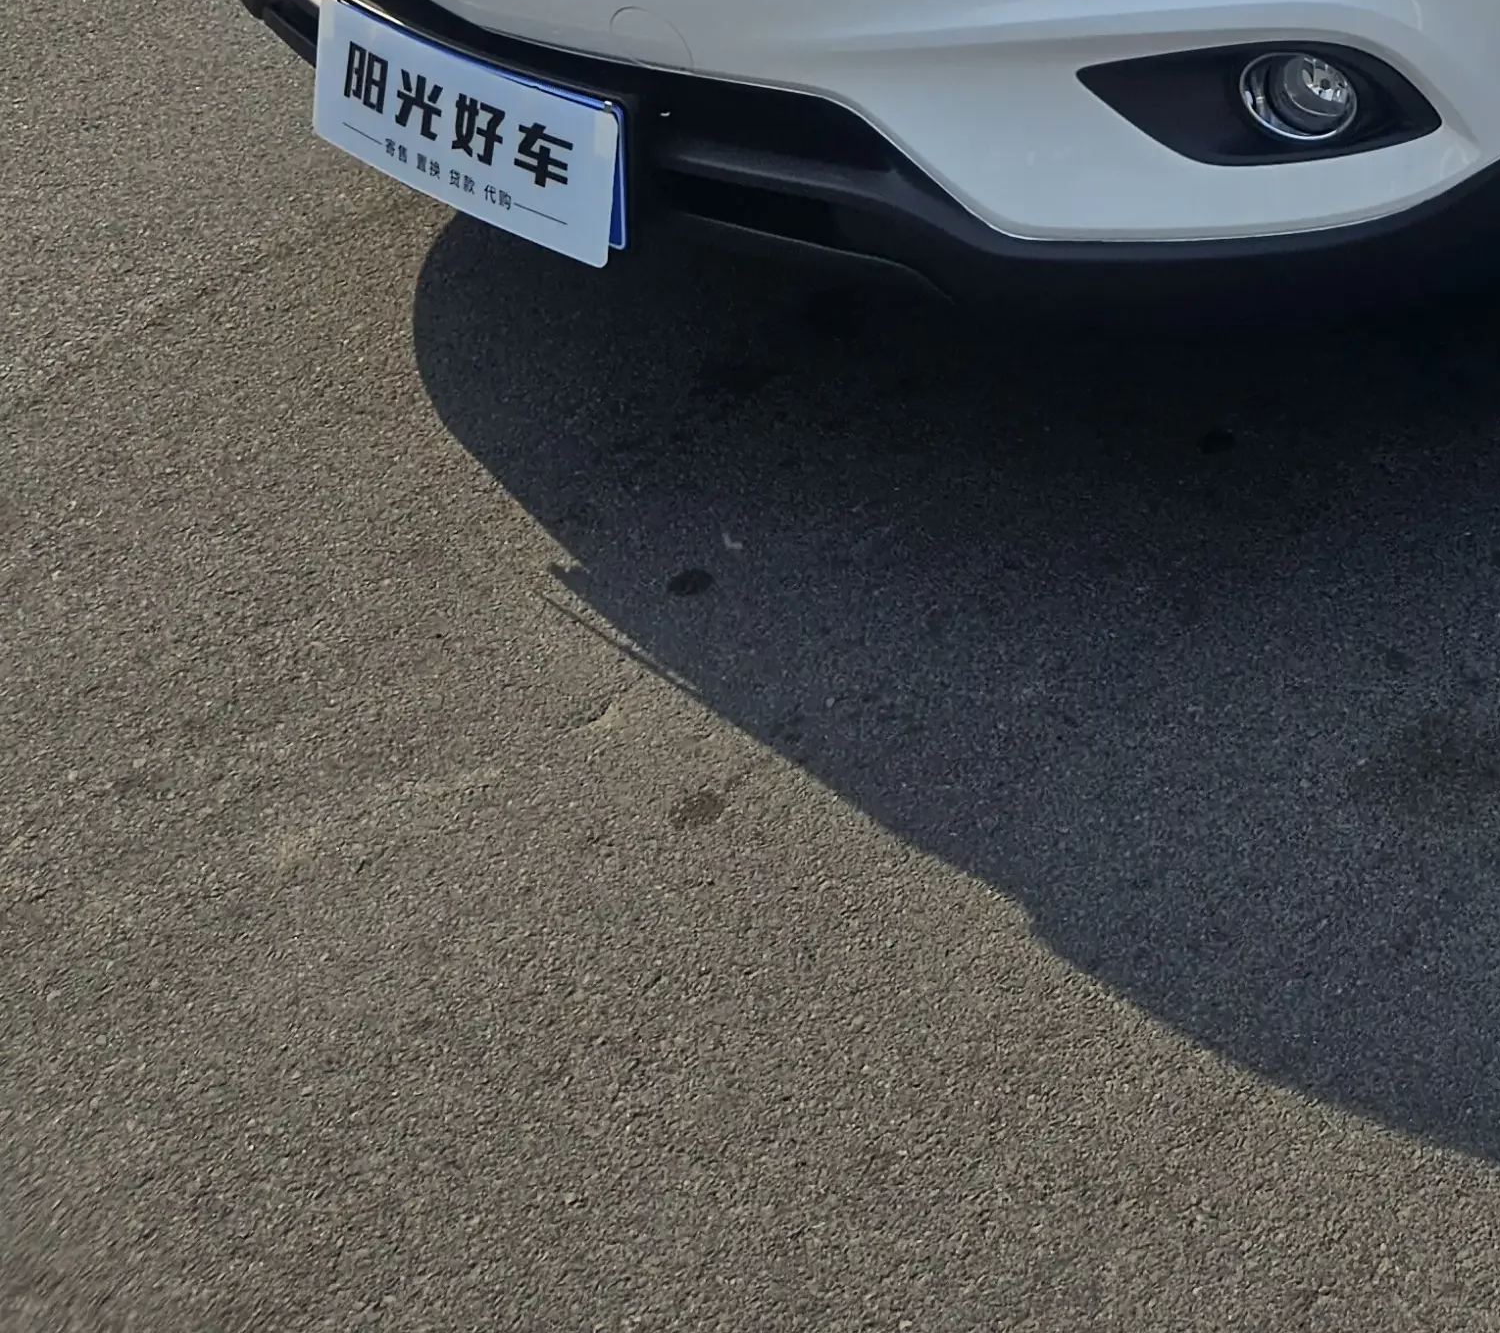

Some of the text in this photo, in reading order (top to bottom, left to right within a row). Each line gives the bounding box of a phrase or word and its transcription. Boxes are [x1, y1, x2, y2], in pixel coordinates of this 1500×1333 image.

[343, 41, 573, 188] 阳光好车
[417, 153, 440, 179] 置换
[449, 169, 475, 195] 贷款
[484, 184, 512, 210] 代购
